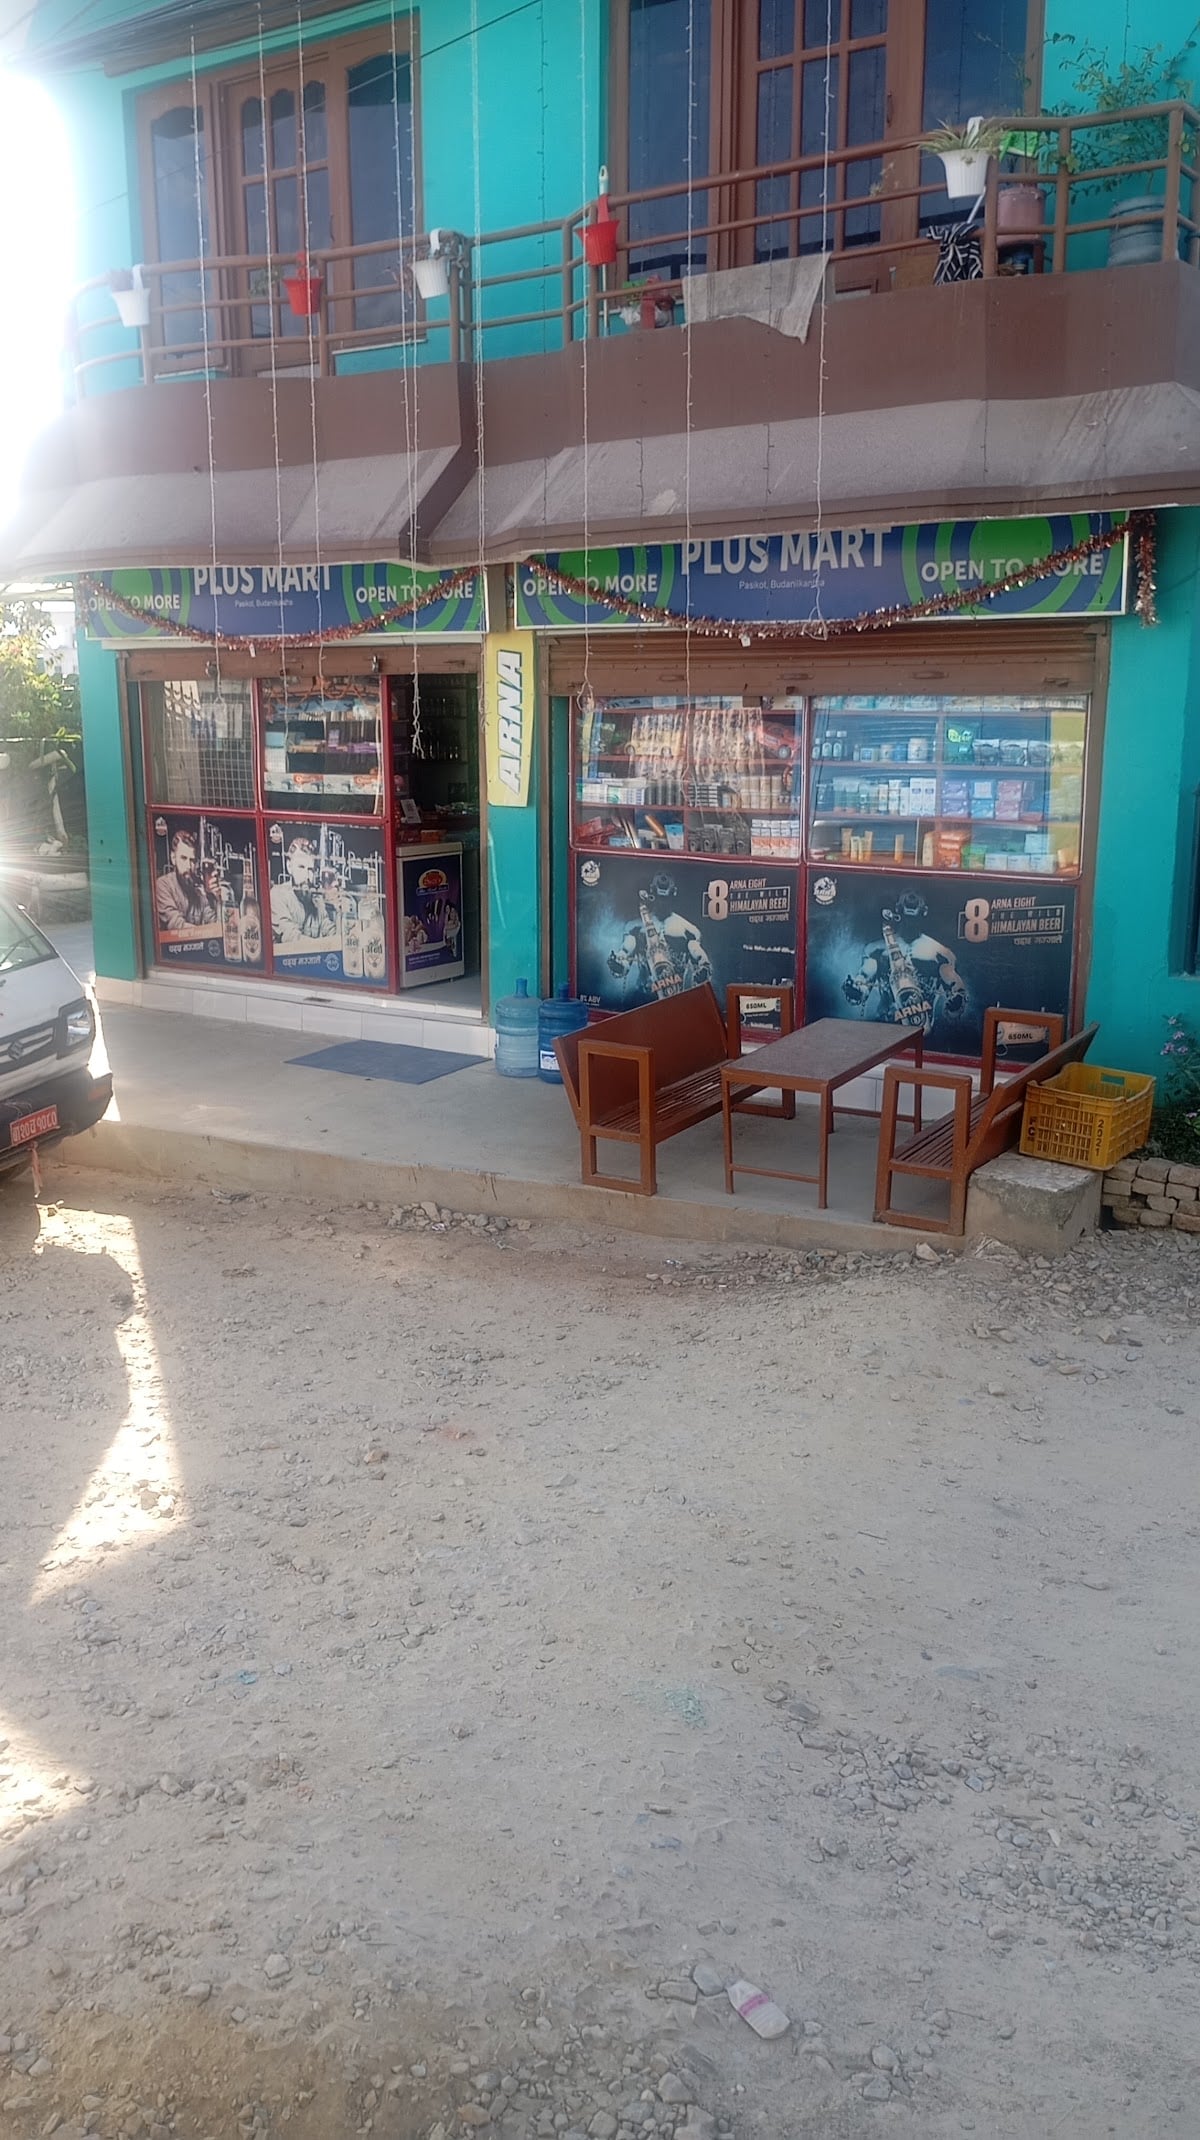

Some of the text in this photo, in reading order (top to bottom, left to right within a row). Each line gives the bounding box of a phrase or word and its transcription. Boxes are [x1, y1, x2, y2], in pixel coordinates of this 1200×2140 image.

[681, 526, 892, 576] PLUS MART
[193, 564, 331, 596] PLUS MART
[921, 559, 984, 582] OPEN
[605, 574, 658, 593] MORE
[143, 594, 180, 610] MORE
[355, 585, 398, 603] OPEN
[496, 649, 523, 795] ARNA
[729, 878, 767, 889] ARNA EIGHT
[707, 879, 729, 921] 8
[729, 897, 787, 912] HIMALAYAN BEER
[991, 896, 1037, 910] ARNA EIGHT
[964, 898, 990, 944] 8
[990, 916, 1061, 934] HIMALAYAN BEER
[651, 974, 682, 993] ARNA
[894, 1000, 932, 1022] ARNA
[1007, 1033, 1033, 1041] 650ML
